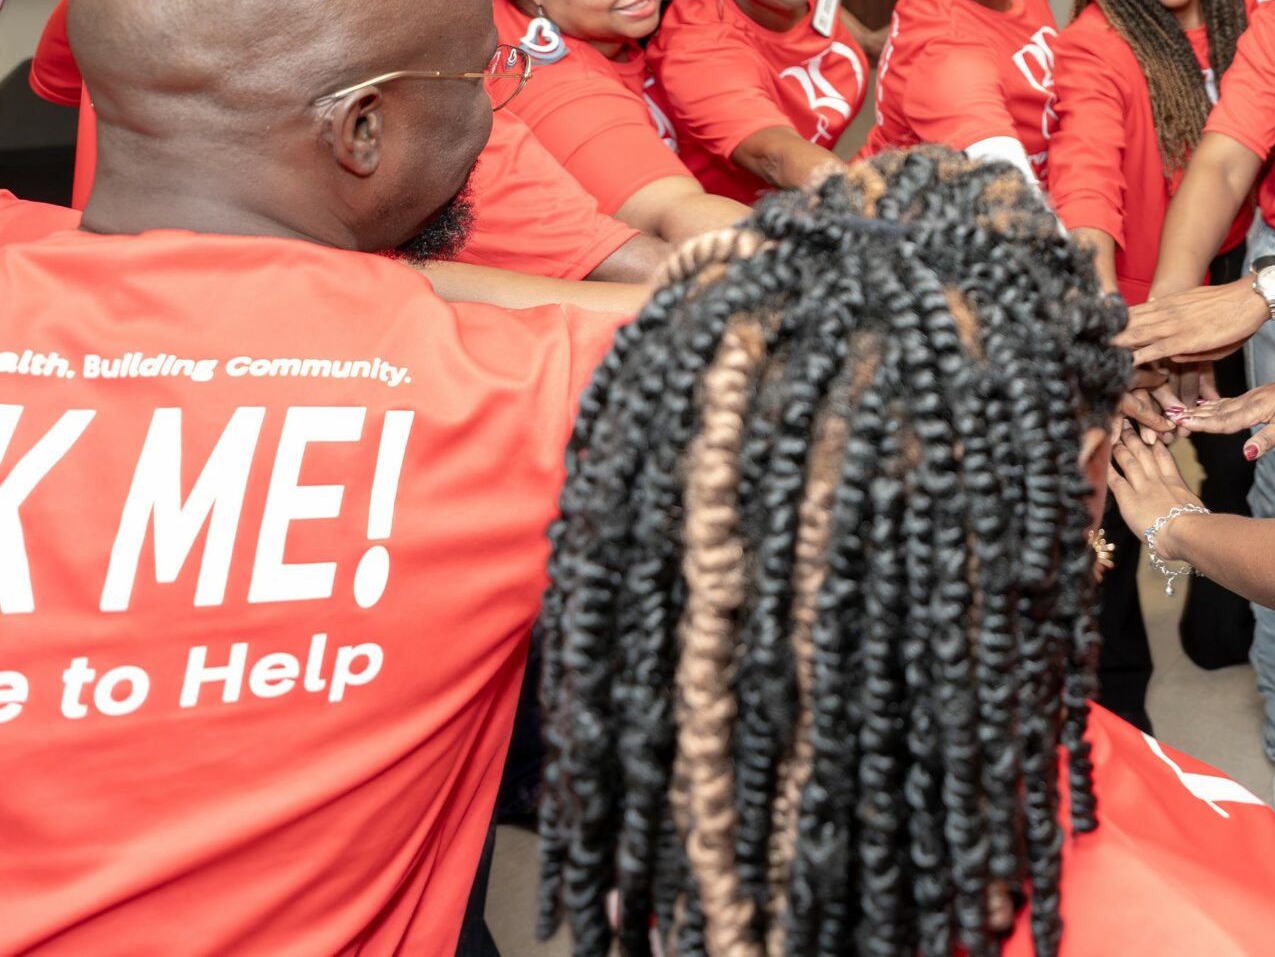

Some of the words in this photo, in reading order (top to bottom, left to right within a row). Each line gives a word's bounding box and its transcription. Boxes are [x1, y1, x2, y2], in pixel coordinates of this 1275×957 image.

[0, 350, 76, 379] alth.
[83, 352, 219, 382] Building
[226, 356, 412, 387] Community.
[0, 404, 97, 614] K
[100, 405, 415, 613] ME!
[0, 668, 29, 723] e
[61, 656, 151, 719] to
[180, 633, 384, 709] Help
